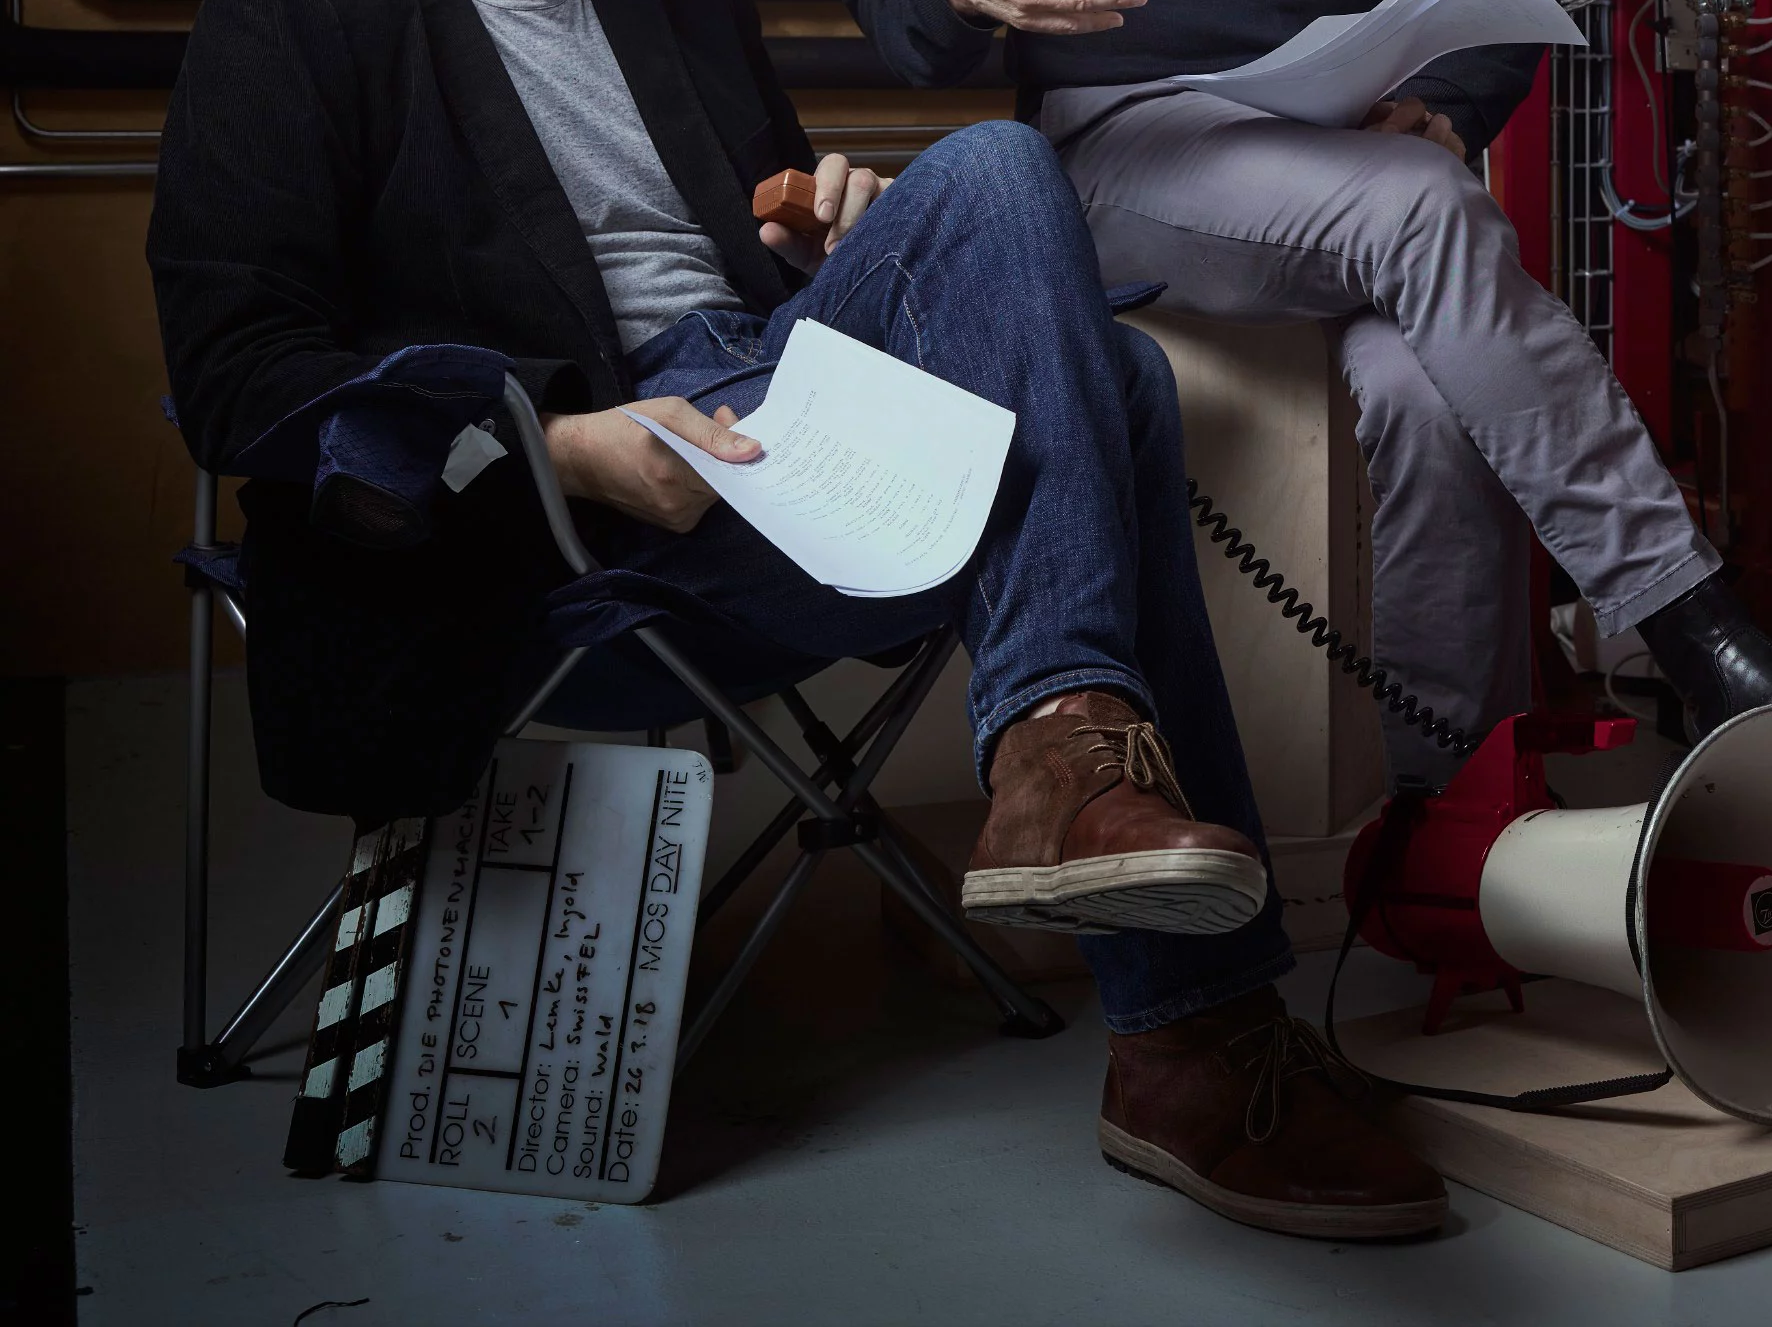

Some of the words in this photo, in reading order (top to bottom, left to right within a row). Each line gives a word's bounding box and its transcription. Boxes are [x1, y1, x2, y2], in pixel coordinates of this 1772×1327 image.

[486, 791, 518, 856] TAKE
[661, 771, 689, 827] NITE
[651, 835, 678, 894] DAY
[639, 902, 669, 972] MOS
[456, 965, 491, 1059] SCENE
[498, 1000, 519, 1021] 1
[518, 1063, 552, 1173] Director:
[554, 872, 587, 939] Ingold
[400, 1086, 431, 1160] Prod.
[418, 1032, 437, 1077] DIE
[439, 1093, 470, 1167] ROLL
[473, 1115, 498, 1145] 2
[546, 1060, 581, 1176] Camera:
[573, 1090, 604, 1179] Sound:
[608, 1102, 640, 1183] Date:
